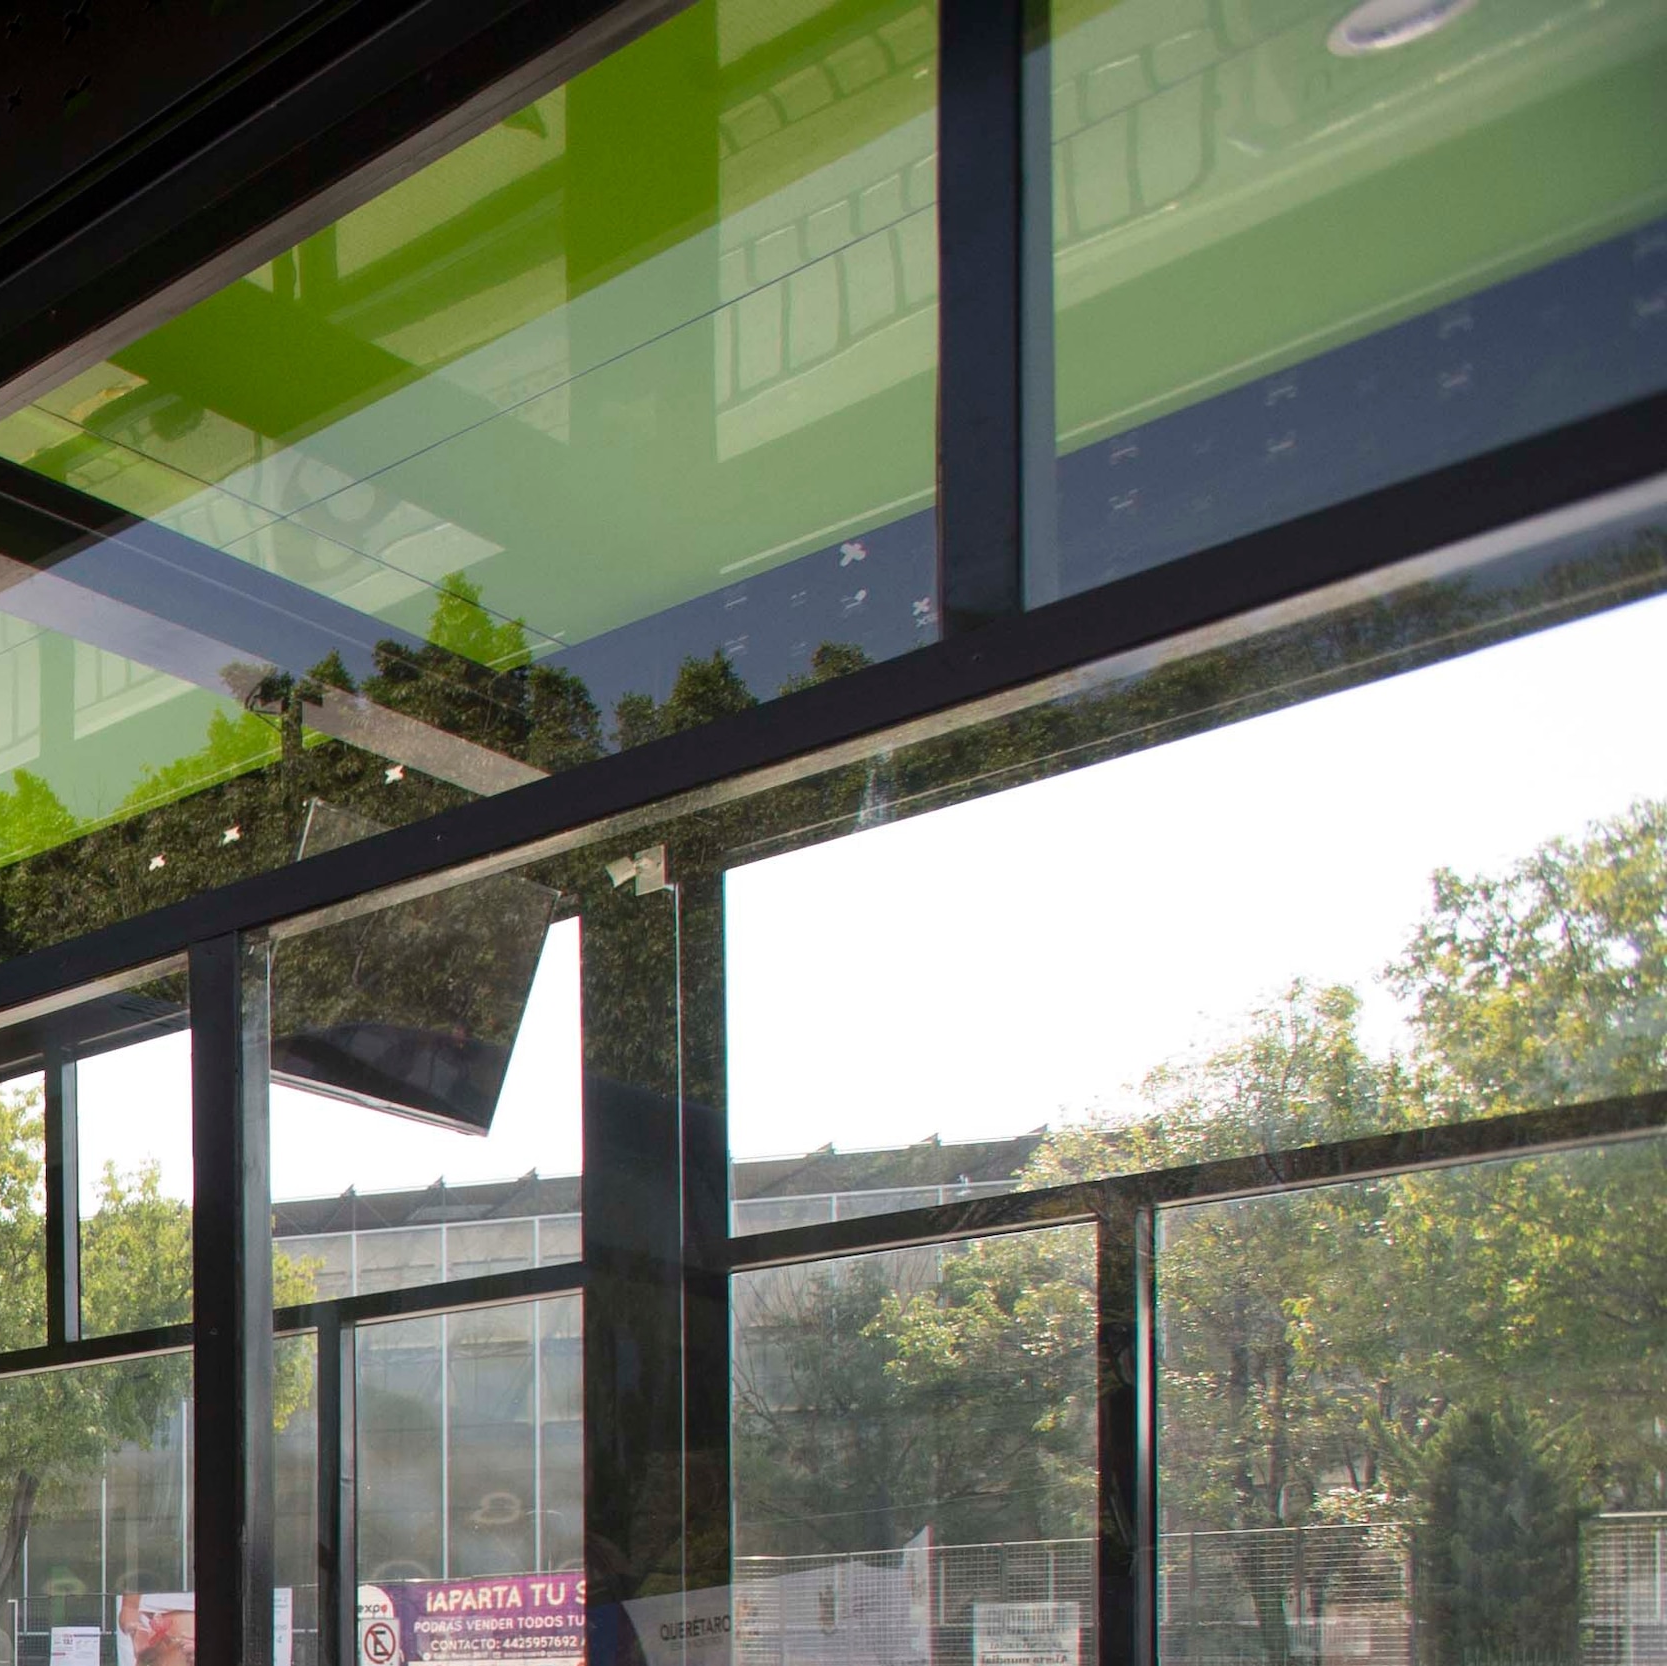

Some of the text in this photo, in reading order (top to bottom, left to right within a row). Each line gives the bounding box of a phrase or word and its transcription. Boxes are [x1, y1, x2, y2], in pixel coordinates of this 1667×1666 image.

[530, 1582, 565, 1606] TU
[466, 1617, 514, 1632] VENDER
[518, 1615, 563, 1629] TODOS
[430, 1637, 501, 1651] CONTACTO:
